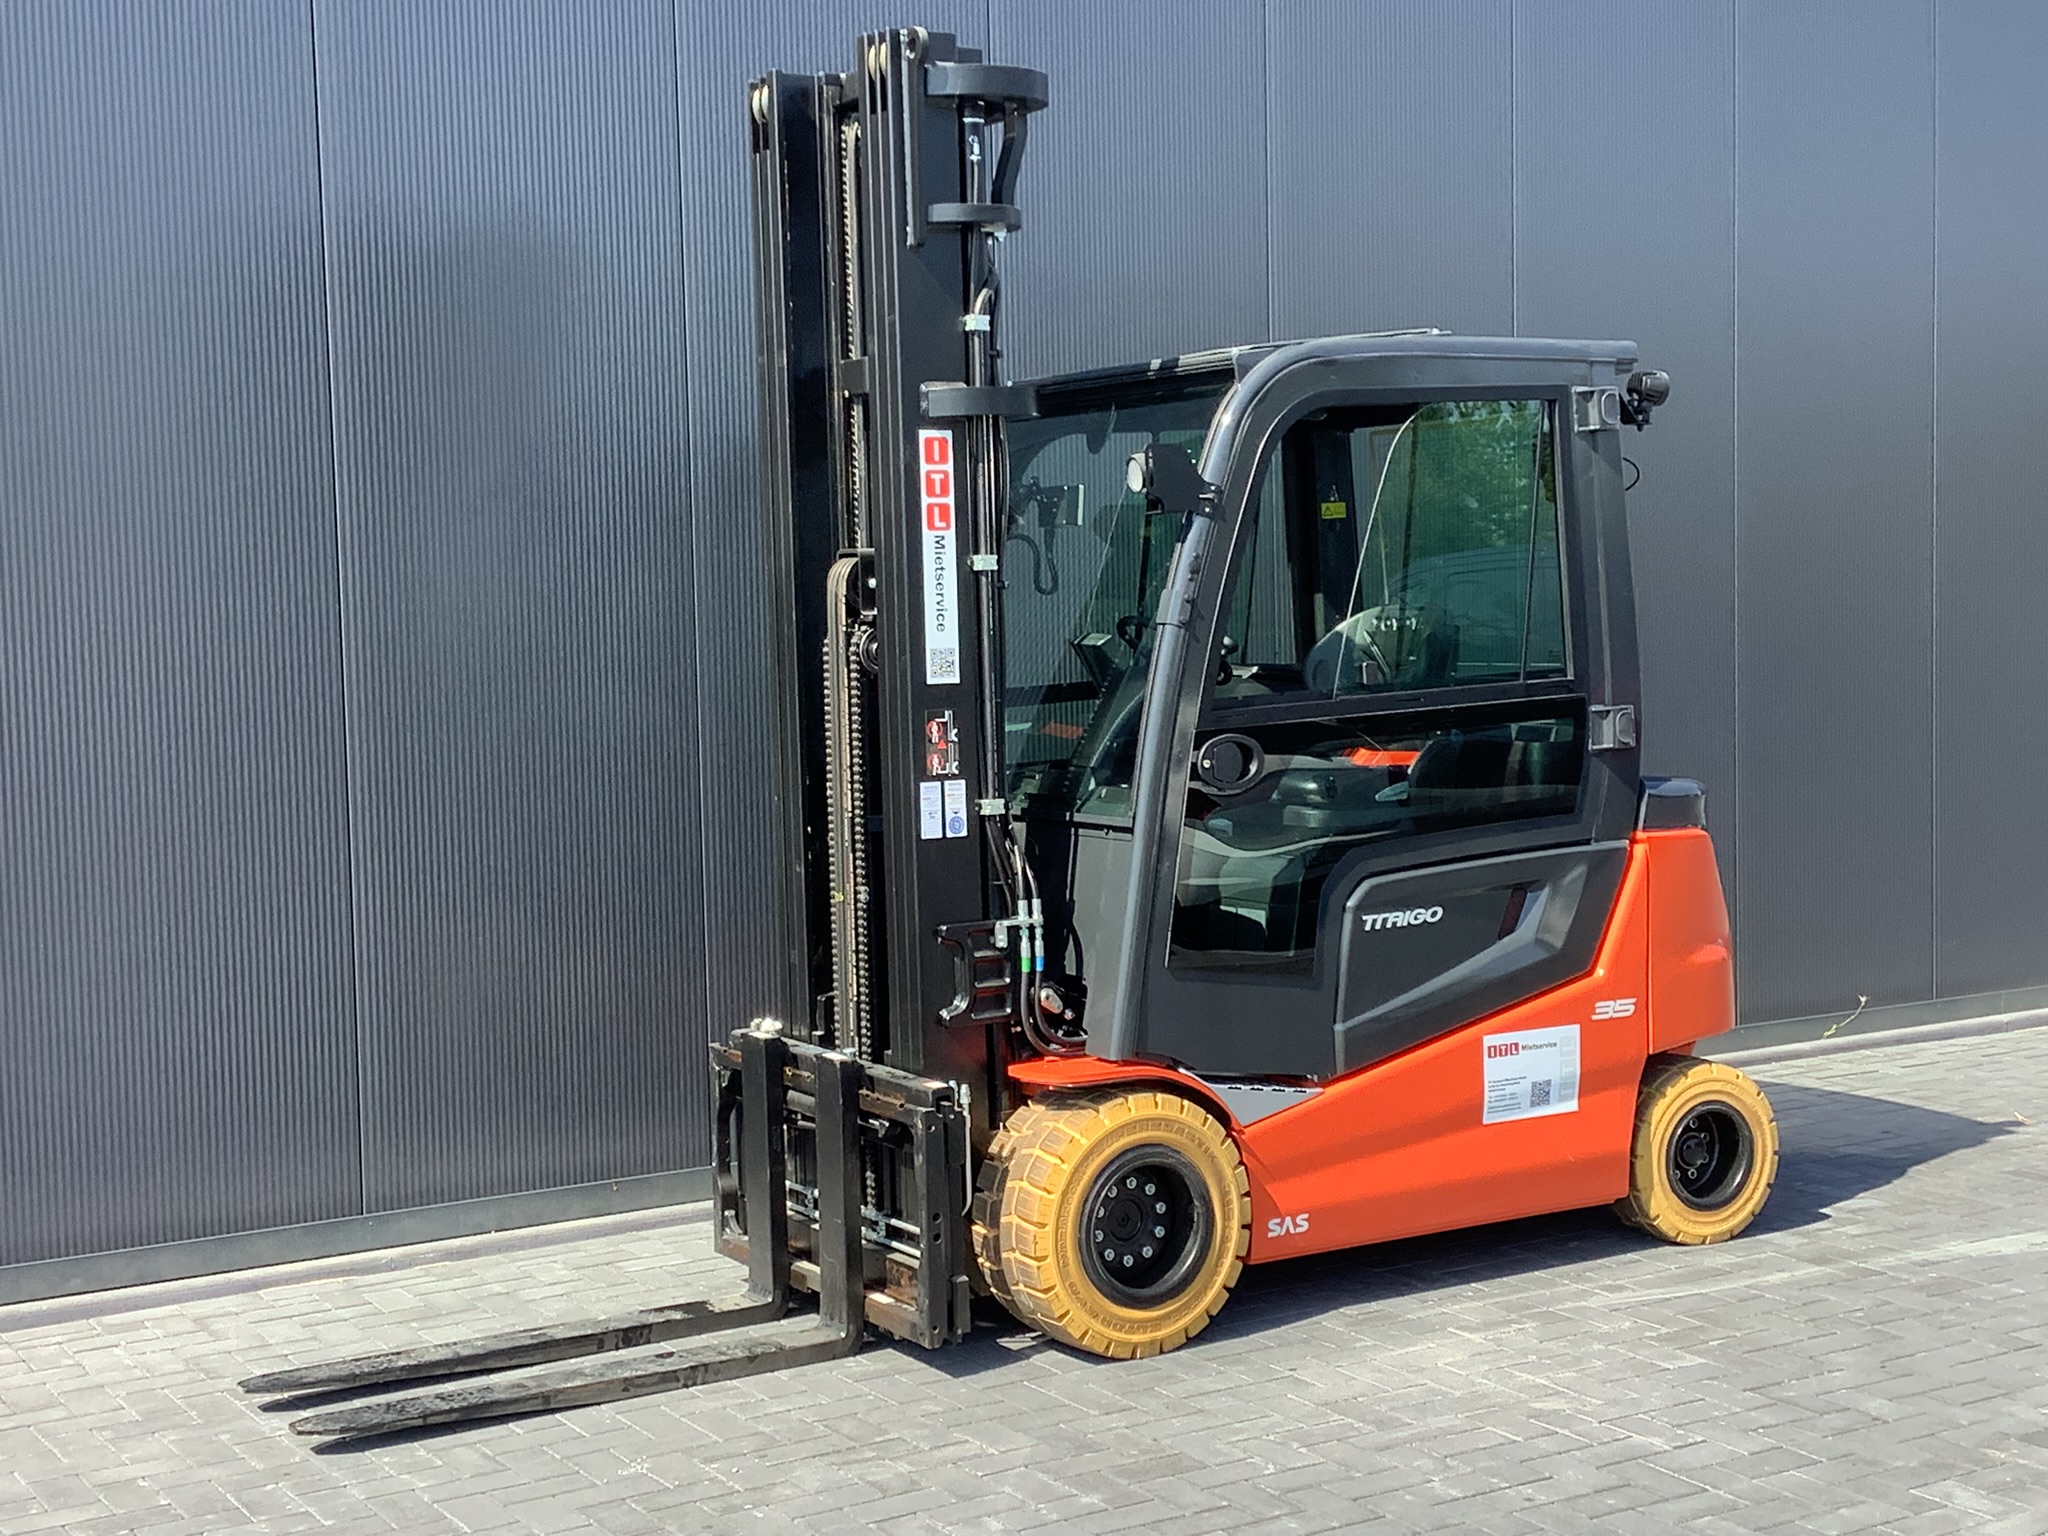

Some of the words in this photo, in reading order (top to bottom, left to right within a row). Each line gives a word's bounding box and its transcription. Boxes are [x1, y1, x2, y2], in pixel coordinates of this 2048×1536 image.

[926, 438, 949, 530] ITL
[933, 534, 947, 633] Mietservice
[1591, 997, 1637, 1020] 35
[1488, 1042, 1519, 1058] ITL
[1521, 1041, 1557, 1051] Mietservice
[1267, 1213, 1309, 1238] SAS
